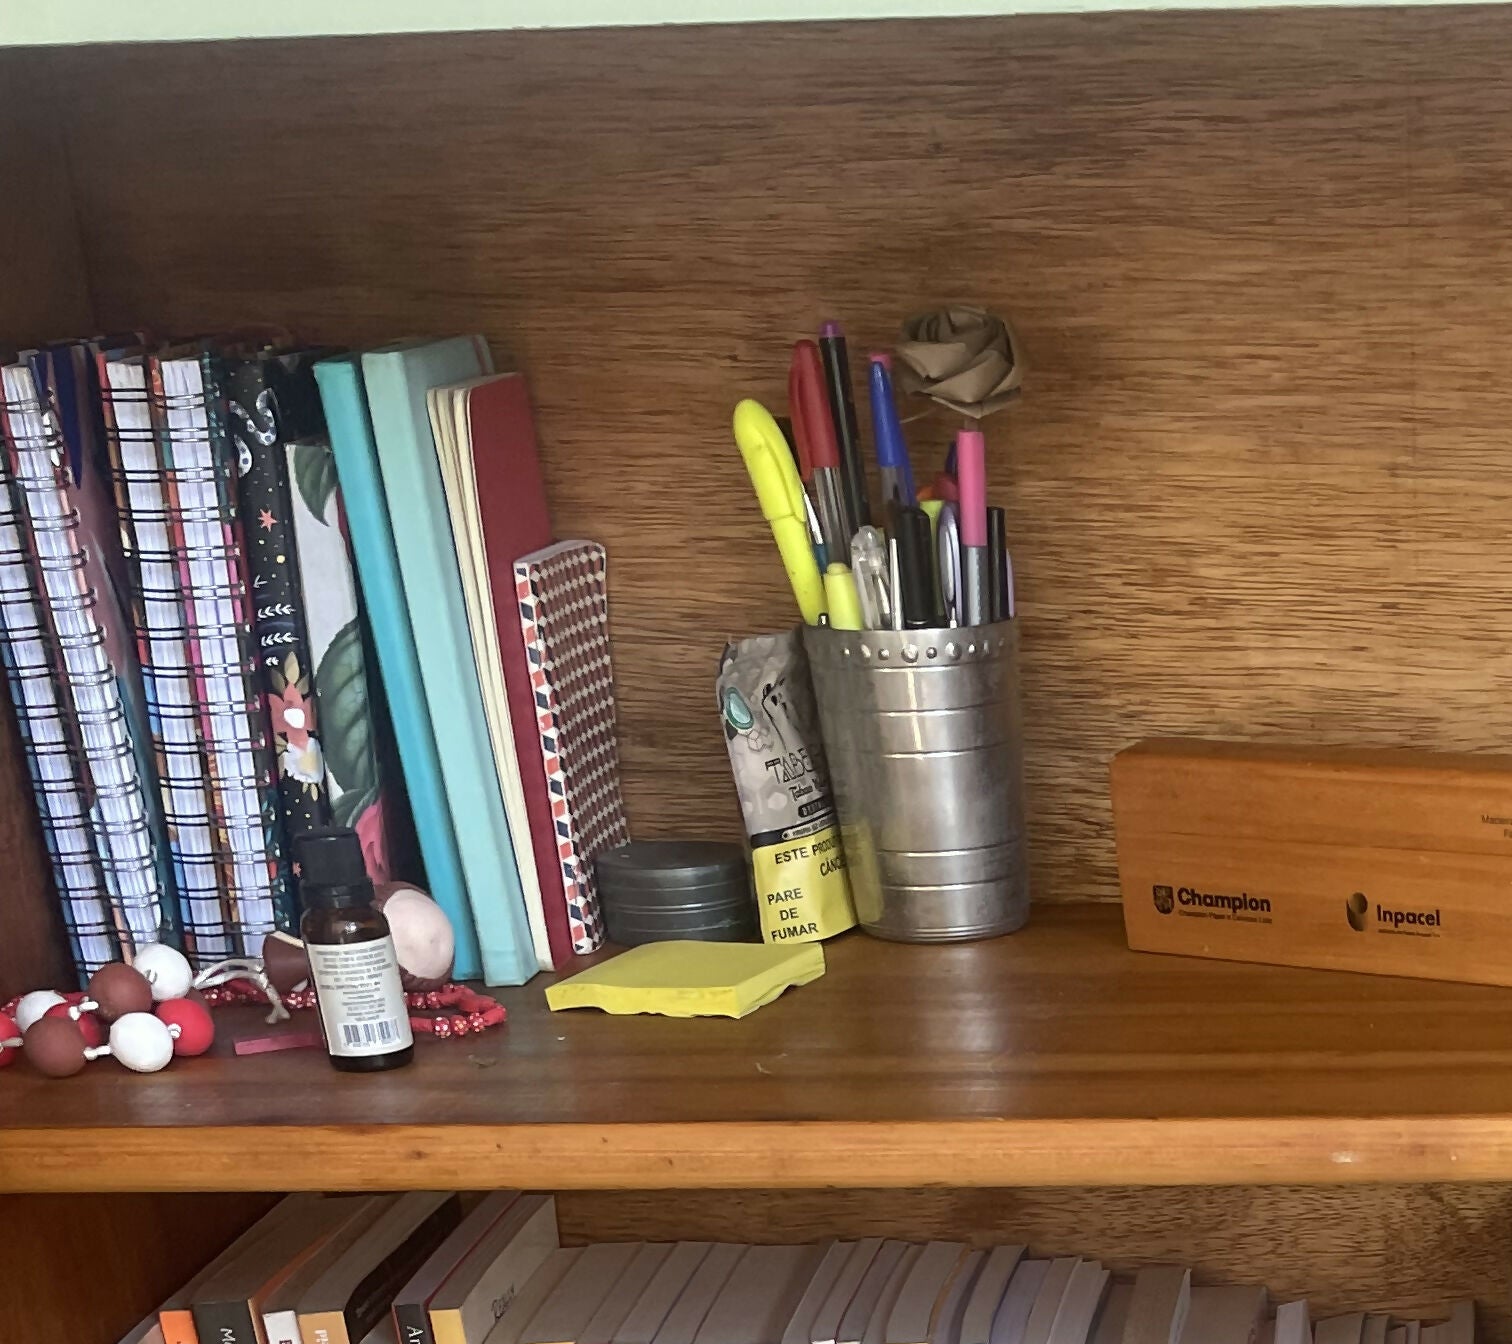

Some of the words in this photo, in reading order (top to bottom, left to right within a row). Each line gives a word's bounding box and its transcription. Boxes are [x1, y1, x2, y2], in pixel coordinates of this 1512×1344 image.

[774, 847, 809, 865] ESTE
[767, 887, 803, 904] PARE
[1177, 887, 1271, 913] Champion
[779, 907, 799, 921] DE
[1376, 903, 1441, 927] Inpacel
[770, 922, 819, 942] FUMAR
